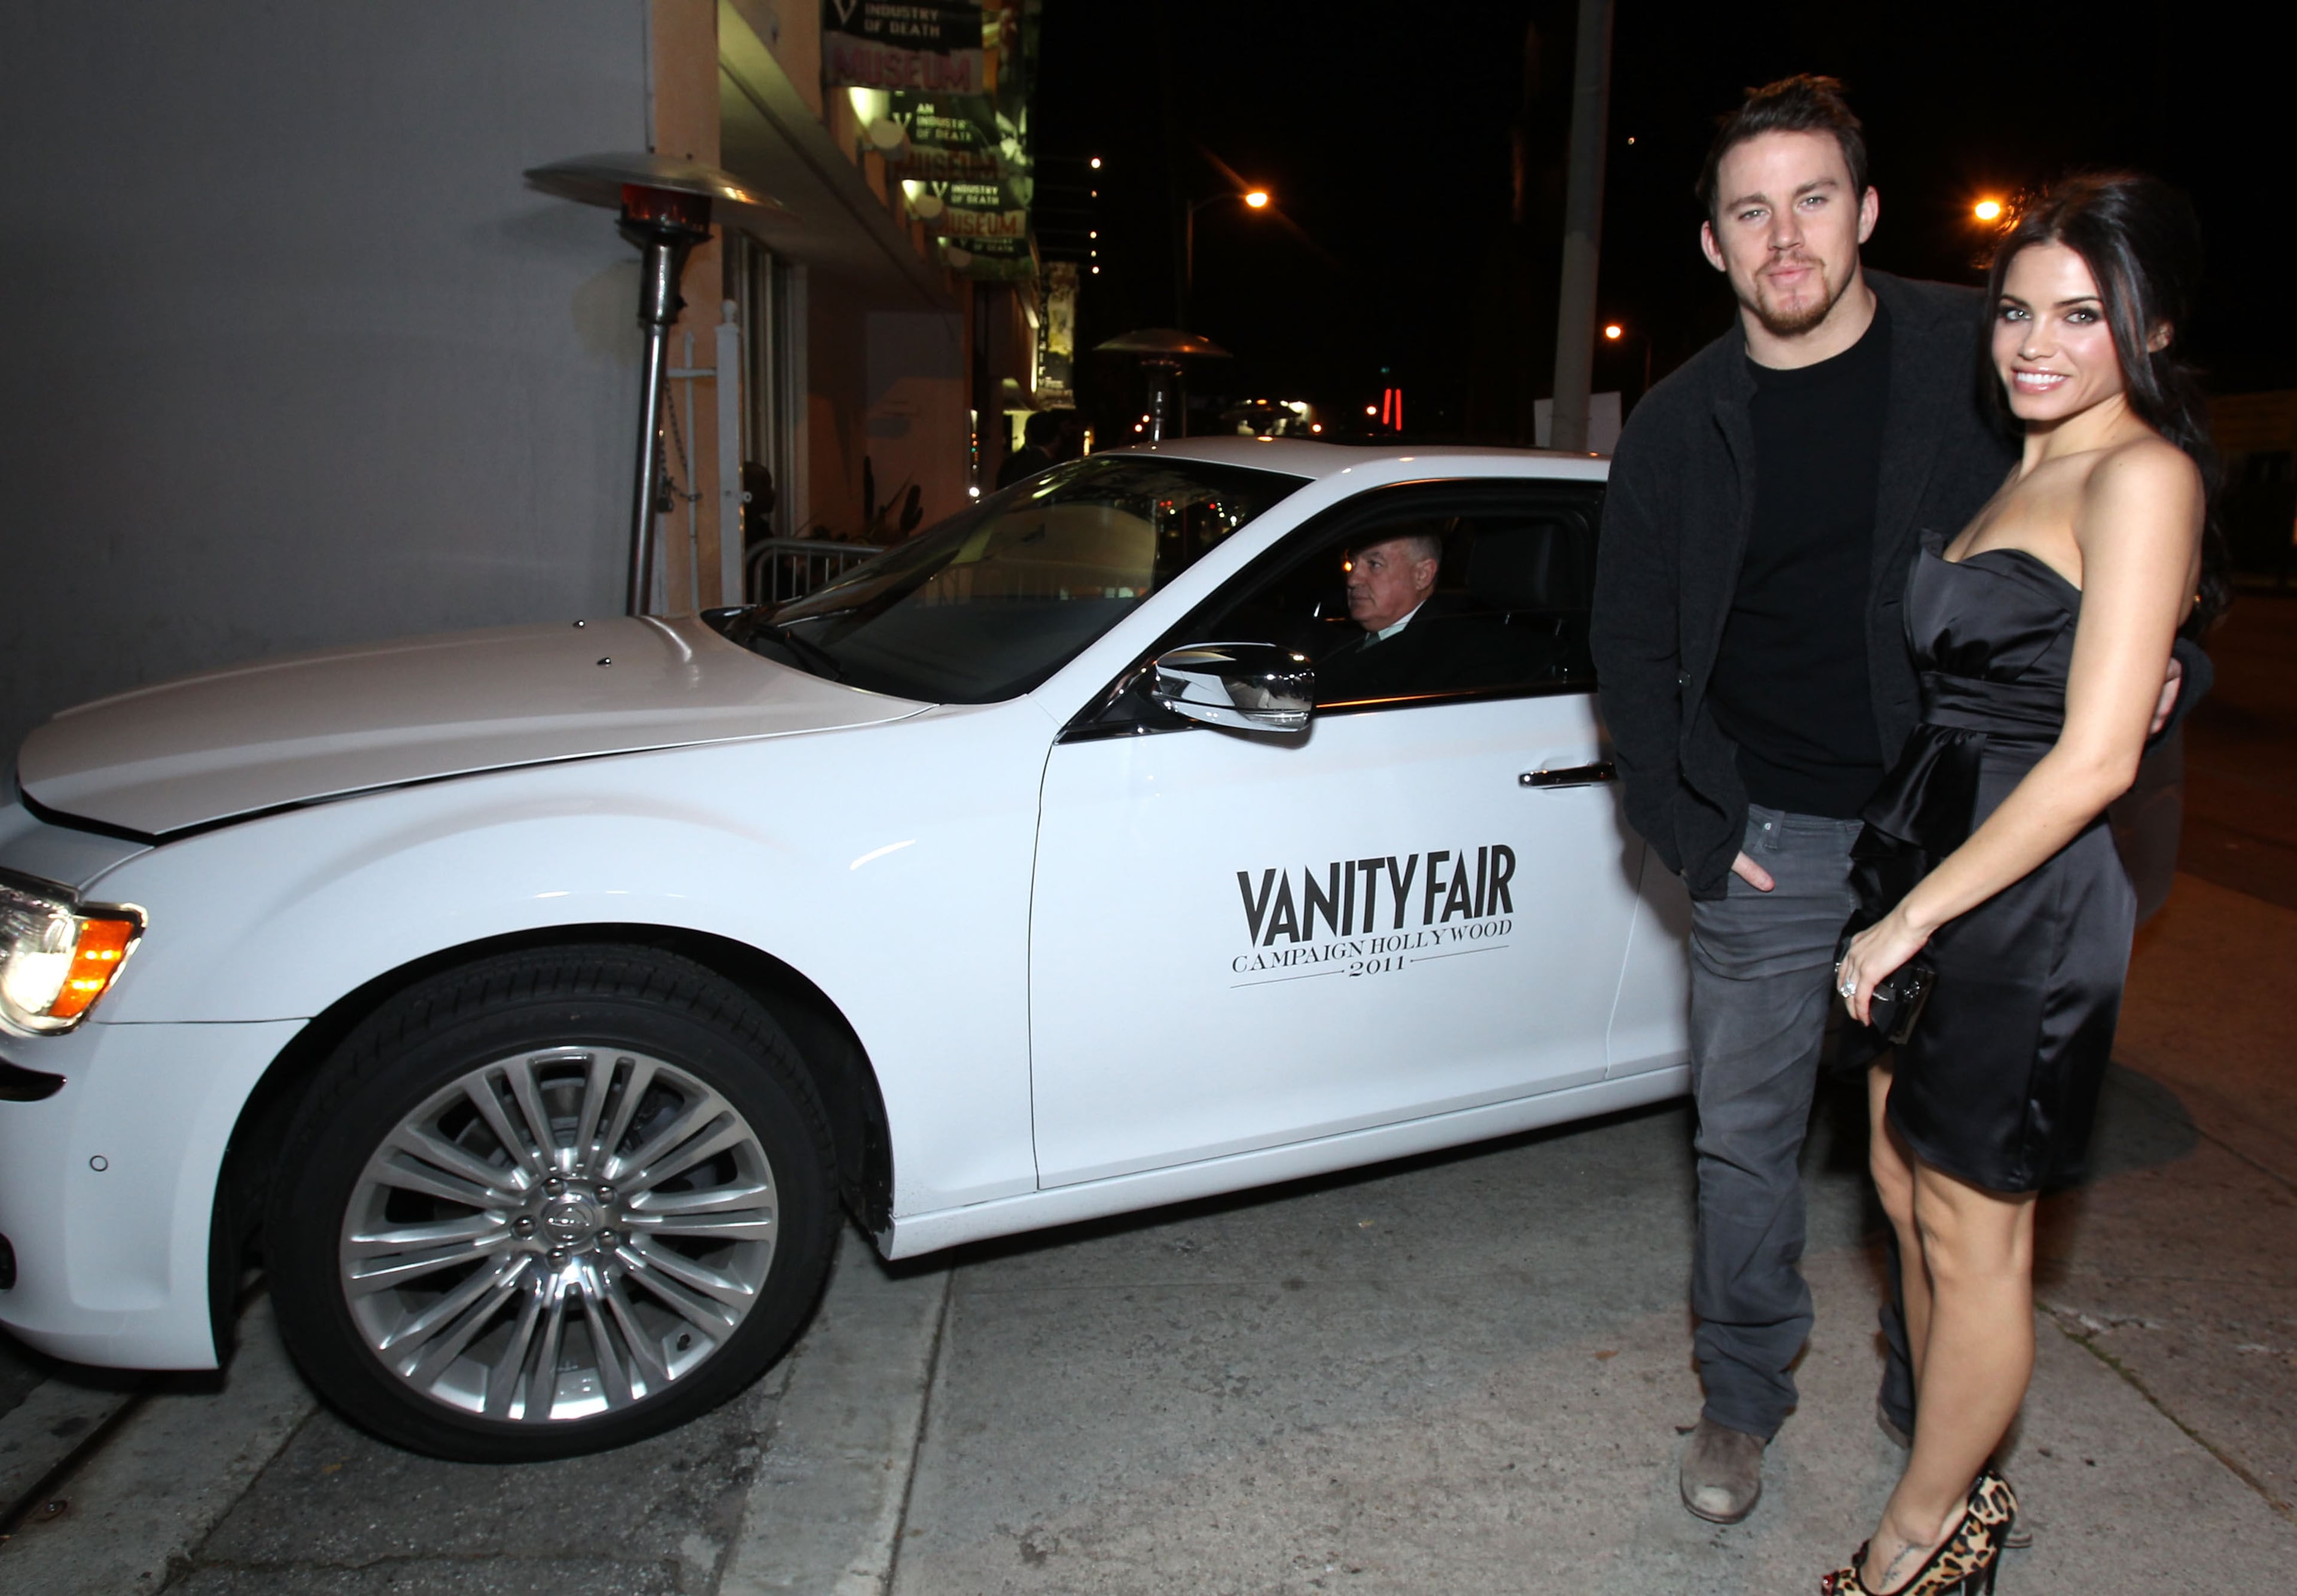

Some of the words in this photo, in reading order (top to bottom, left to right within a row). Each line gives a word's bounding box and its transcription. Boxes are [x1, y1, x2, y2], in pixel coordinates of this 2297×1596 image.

[864, 2, 939, 22] INDUSTRY
[863, 19, 883, 33] OF
[889, 21, 941, 39] DEATH
[834, 45, 971, 92] MUSEUM
[916, 103, 935, 115] AN
[951, 184, 999, 195] INDUSTRY
[951, 193, 963, 205] OF
[966, 194, 1000, 206] DEATH
[1236, 854, 1419, 949] VANITY
[1423, 844, 1516, 925] FAIR
[1232, 940, 1366, 973] CAMPAIGN
[1370, 919, 1512, 955] HOLLYWOOD
[1349, 957, 1405, 977] 2011
